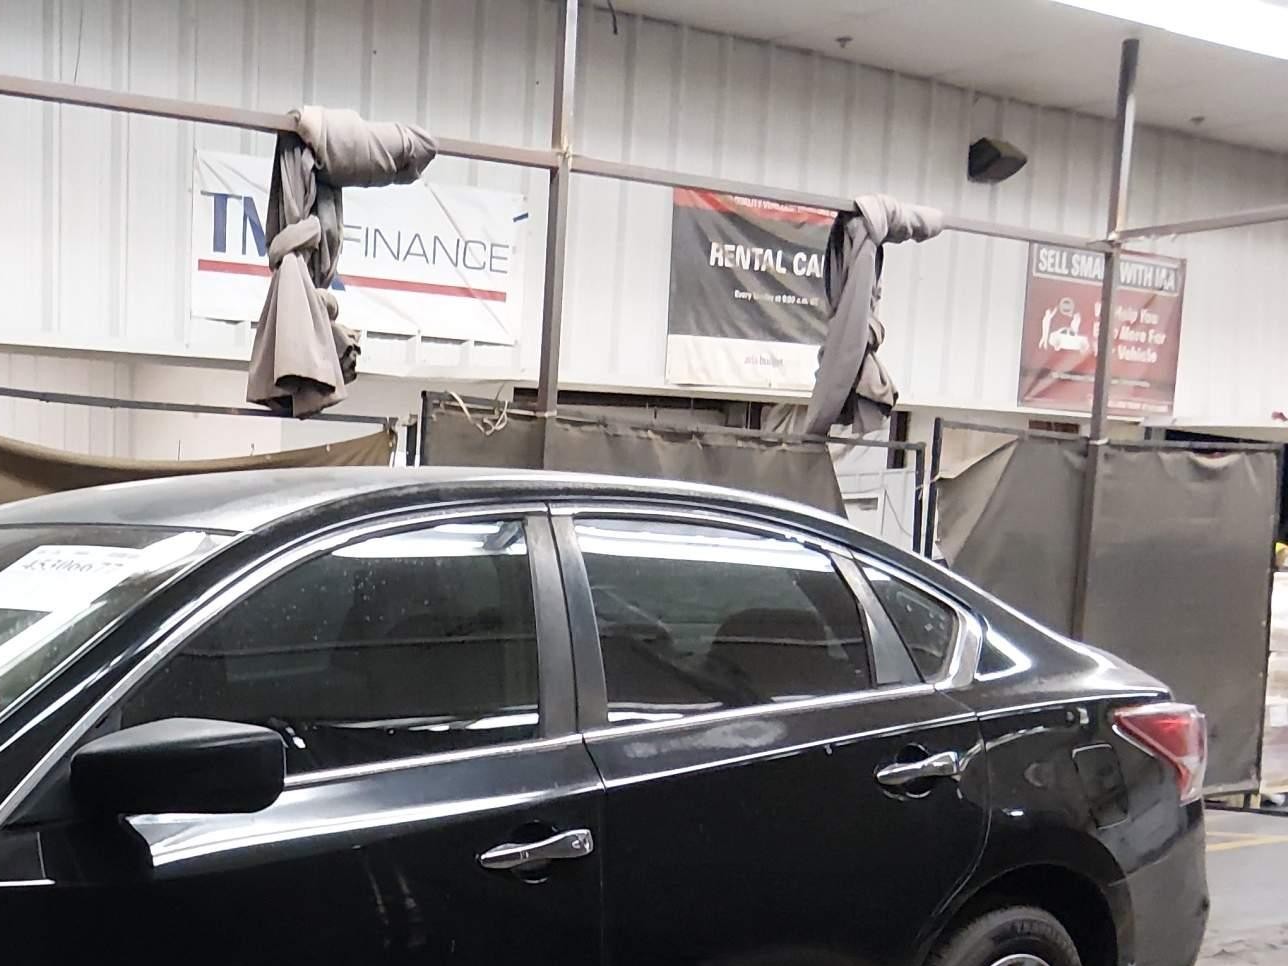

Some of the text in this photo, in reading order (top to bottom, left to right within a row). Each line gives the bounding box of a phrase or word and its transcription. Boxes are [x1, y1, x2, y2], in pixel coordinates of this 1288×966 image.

[342, 225, 510, 274] FINANCE
[710, 242, 825, 279] RENTAL CA
[1038, 248, 1069, 274] SELL
[1072, 254, 1105, 280] SMA
[1120, 262, 1154, 287] WITH
